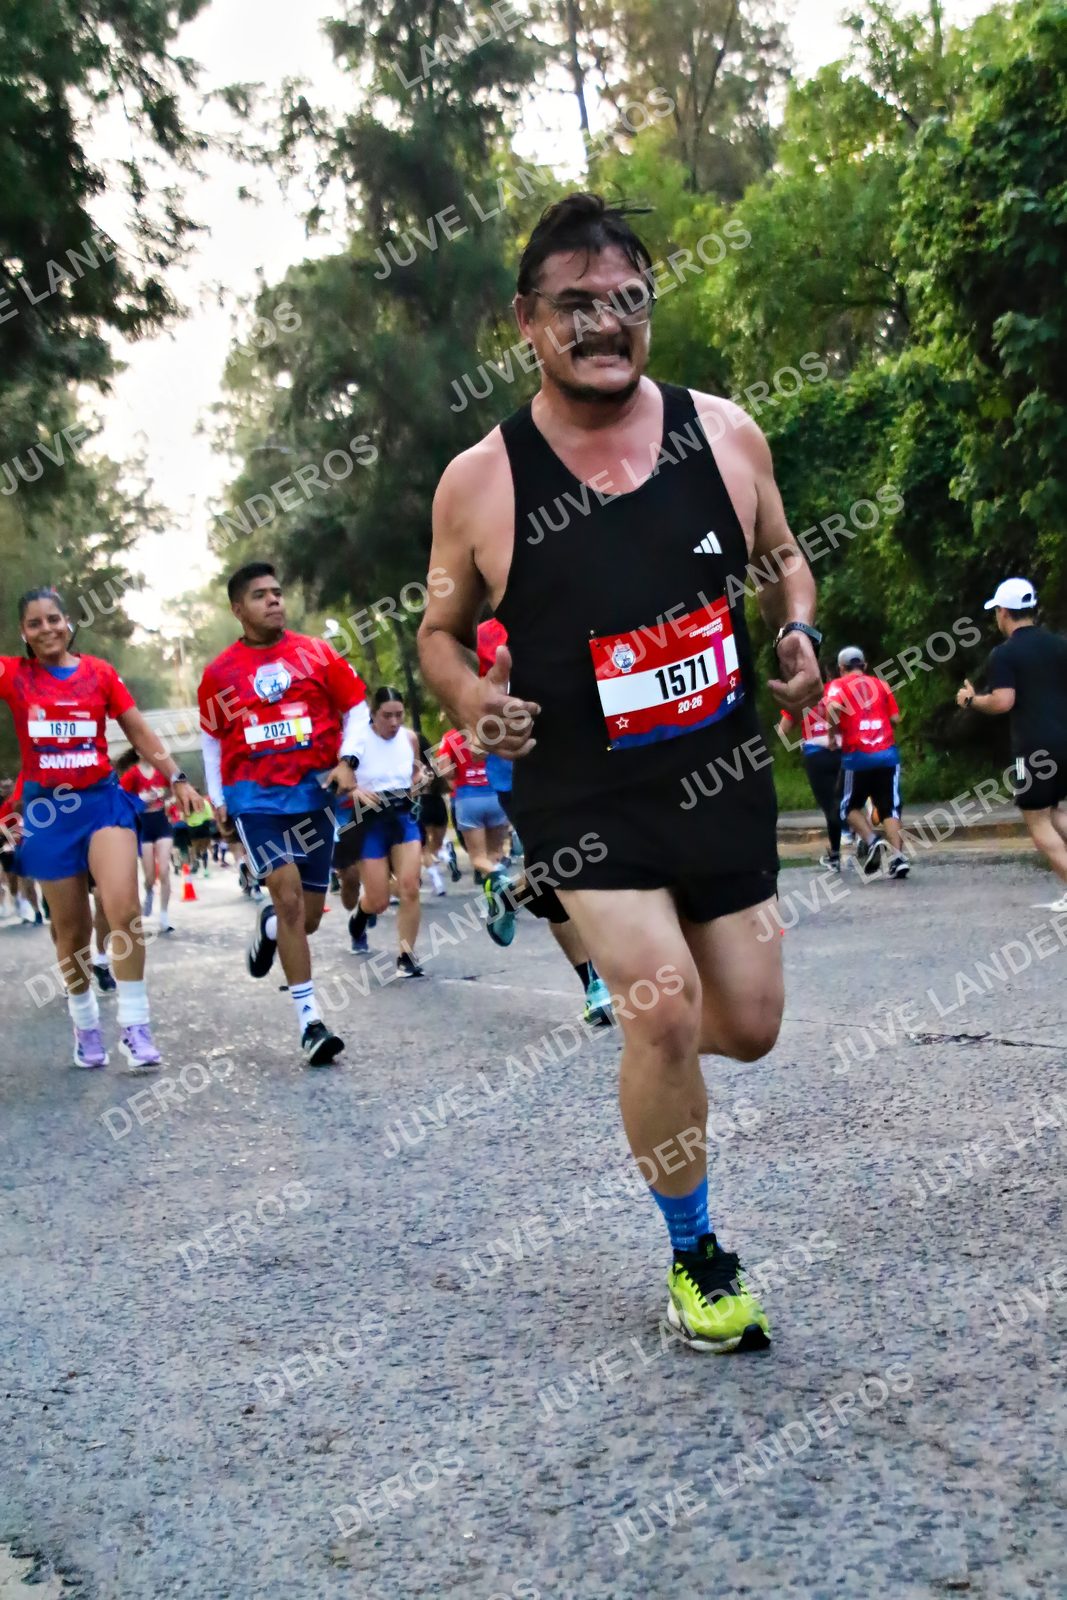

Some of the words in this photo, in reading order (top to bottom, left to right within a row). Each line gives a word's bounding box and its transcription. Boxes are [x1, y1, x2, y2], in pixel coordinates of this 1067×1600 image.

[655, 654, 709, 700] 1571
[50, 723, 76, 736] 1670
[263, 722, 291, 738] 2021
